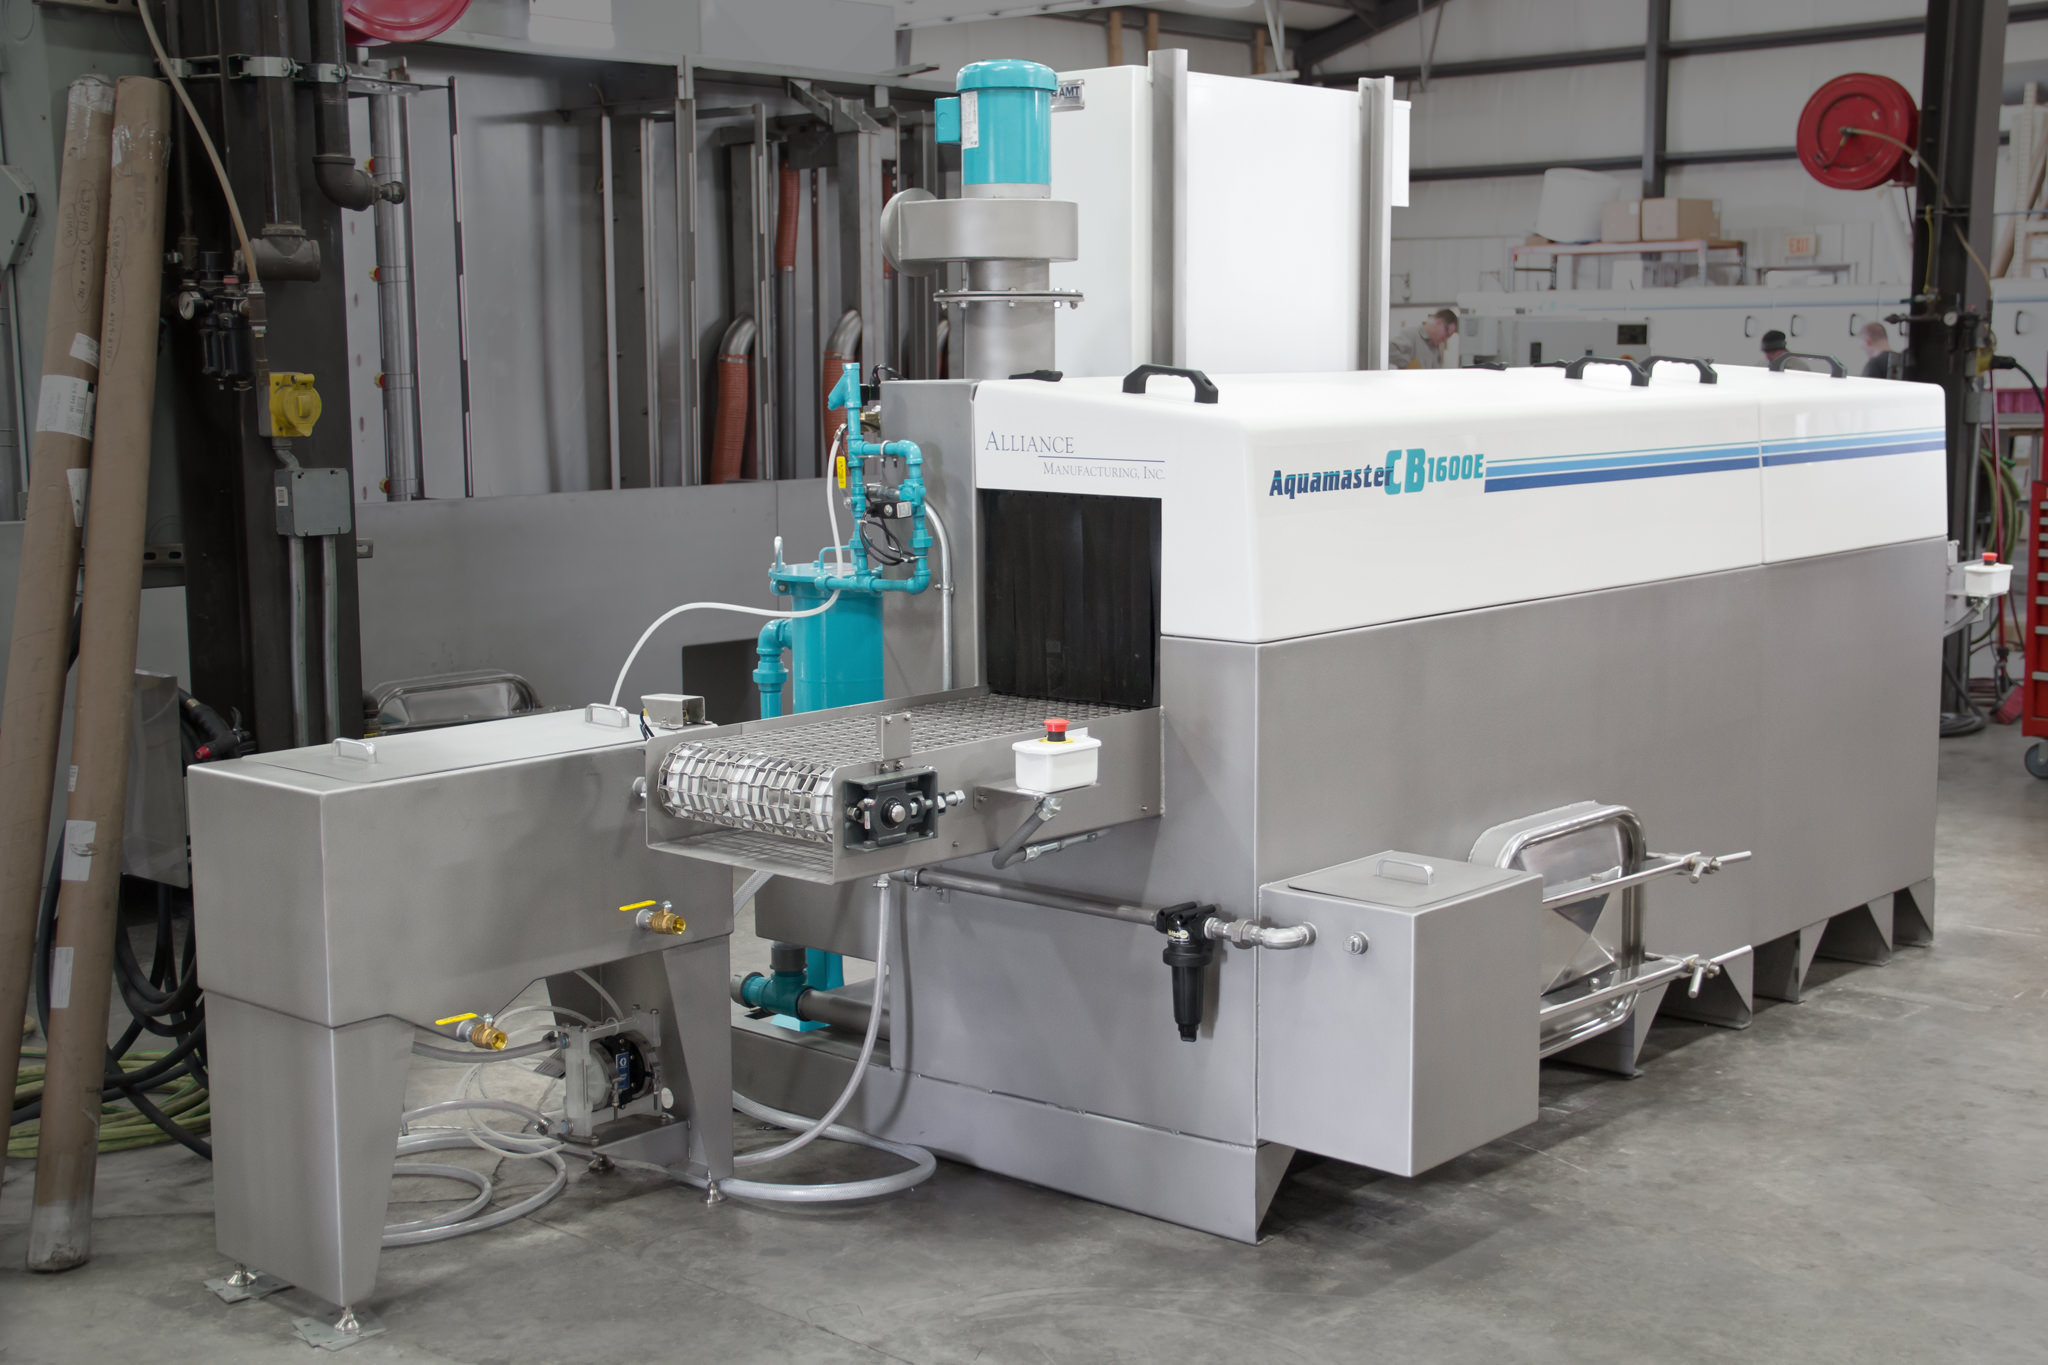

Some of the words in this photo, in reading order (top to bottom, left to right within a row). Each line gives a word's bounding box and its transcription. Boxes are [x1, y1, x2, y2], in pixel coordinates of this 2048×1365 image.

[1788, 236, 1811, 255] EXIT
[985, 430, 1074, 454] ALLIANCE
[1043, 462, 1140, 480] MANUFACTURING,
[1143, 465, 1166, 480] INC.
[1269, 464, 1394, 500] Aquamaster
